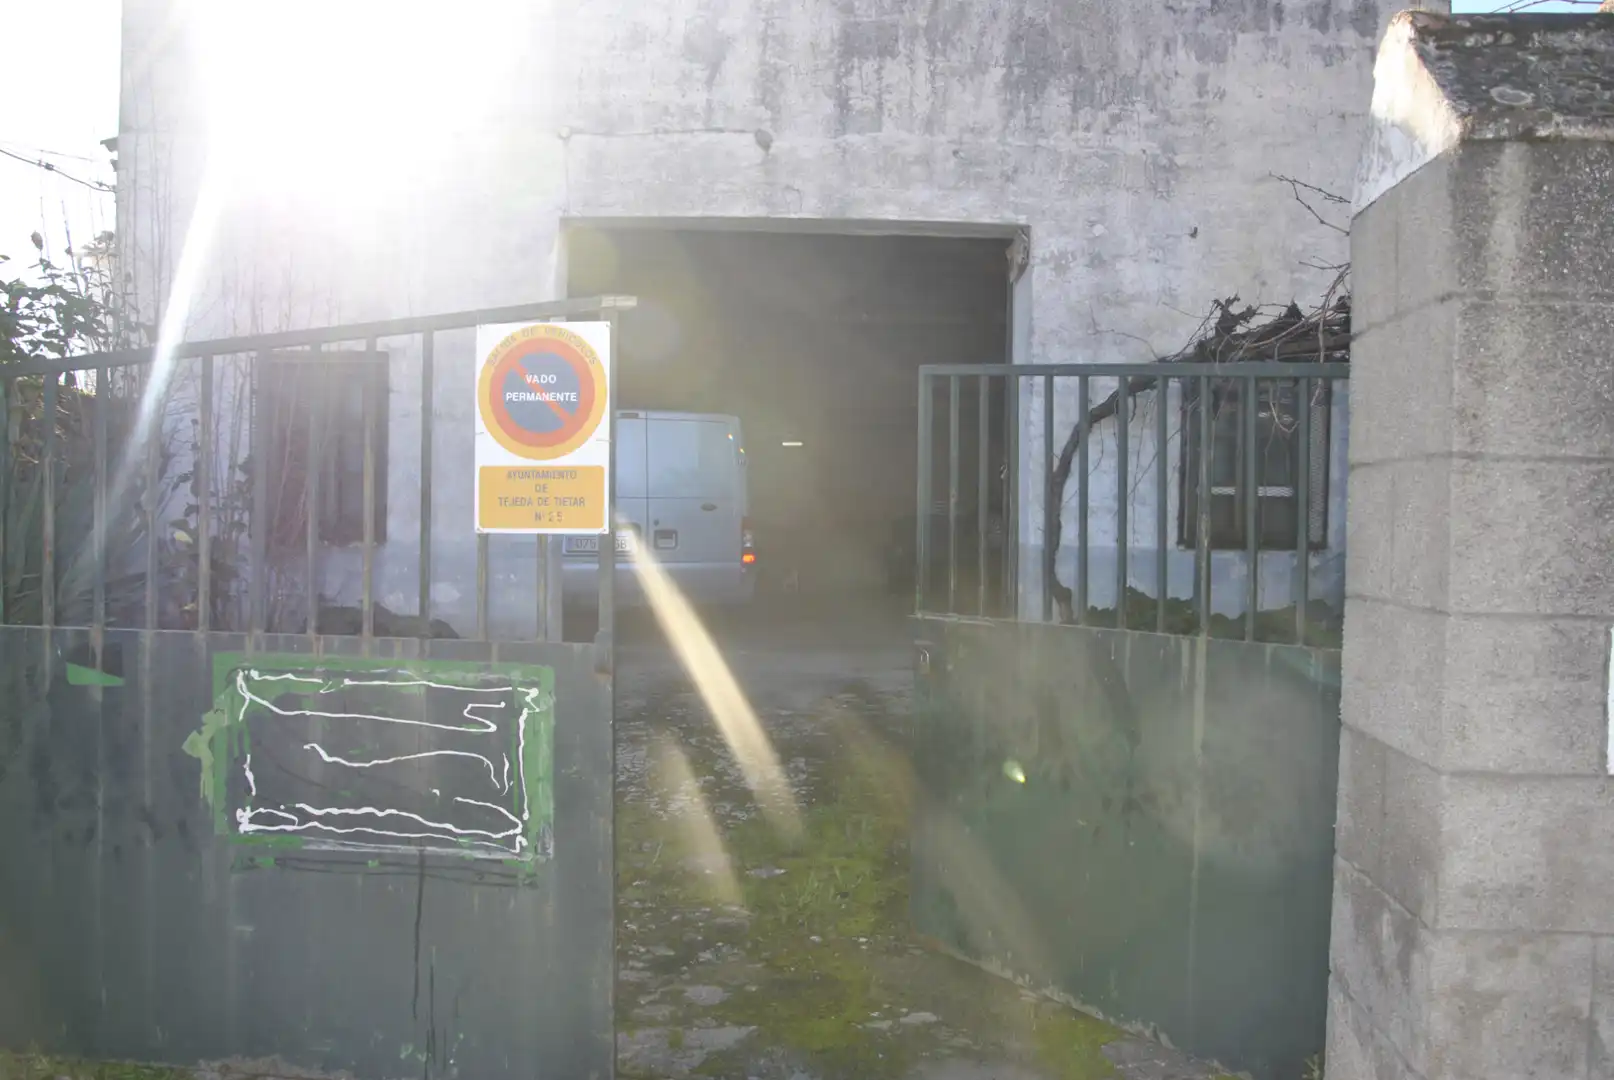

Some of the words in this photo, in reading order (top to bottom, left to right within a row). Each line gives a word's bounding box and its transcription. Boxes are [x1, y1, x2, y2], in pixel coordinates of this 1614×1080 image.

[525, 374, 557, 384] VADO
[506, 392, 578, 402] PERMANENTE
[507, 470, 577, 480] AYUNTAMIENTO
[534, 483, 549, 493] DE
[498, 496, 533, 507] TEJEDA
[537, 496, 550, 507] DE
[554, 496, 585, 507] TIETAR
